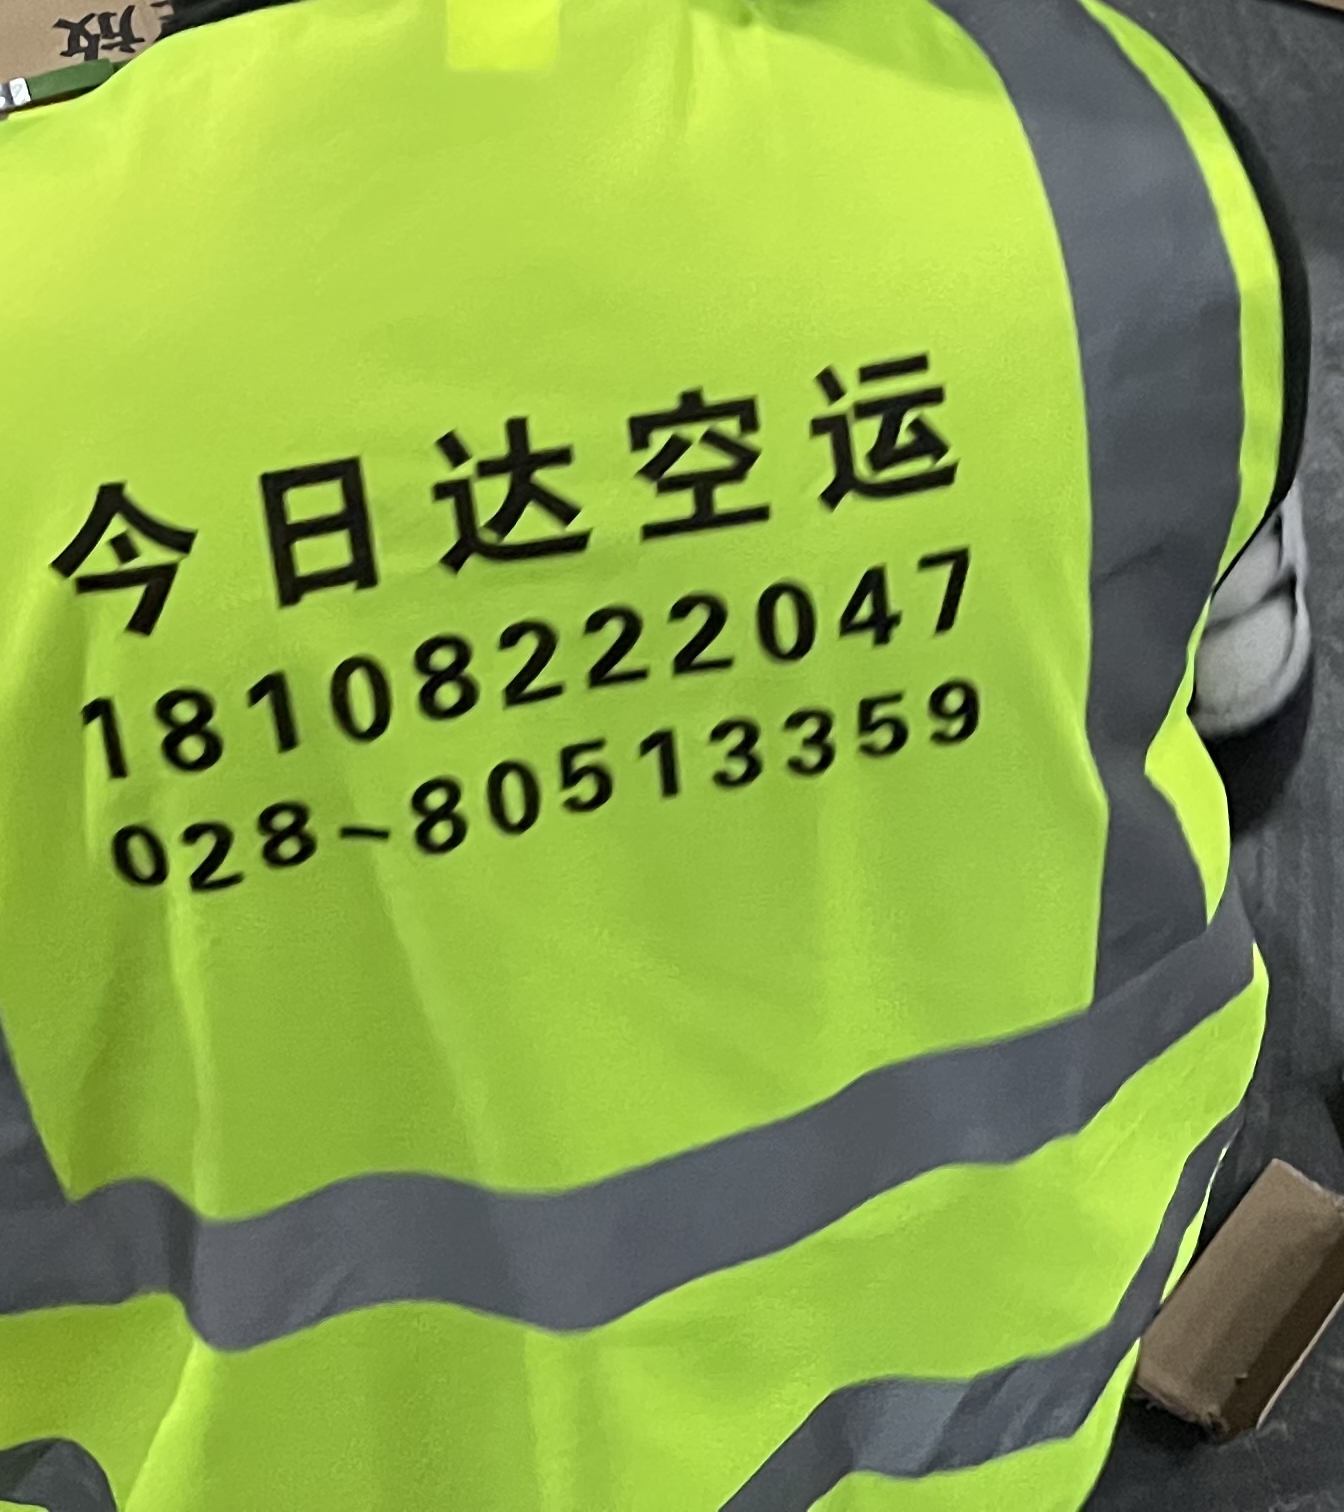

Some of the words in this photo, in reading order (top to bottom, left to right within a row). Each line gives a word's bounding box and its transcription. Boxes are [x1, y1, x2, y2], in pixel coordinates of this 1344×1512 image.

[48, 351, 962, 638] 今日达空运
[78, 544, 973, 781] 18108222047
